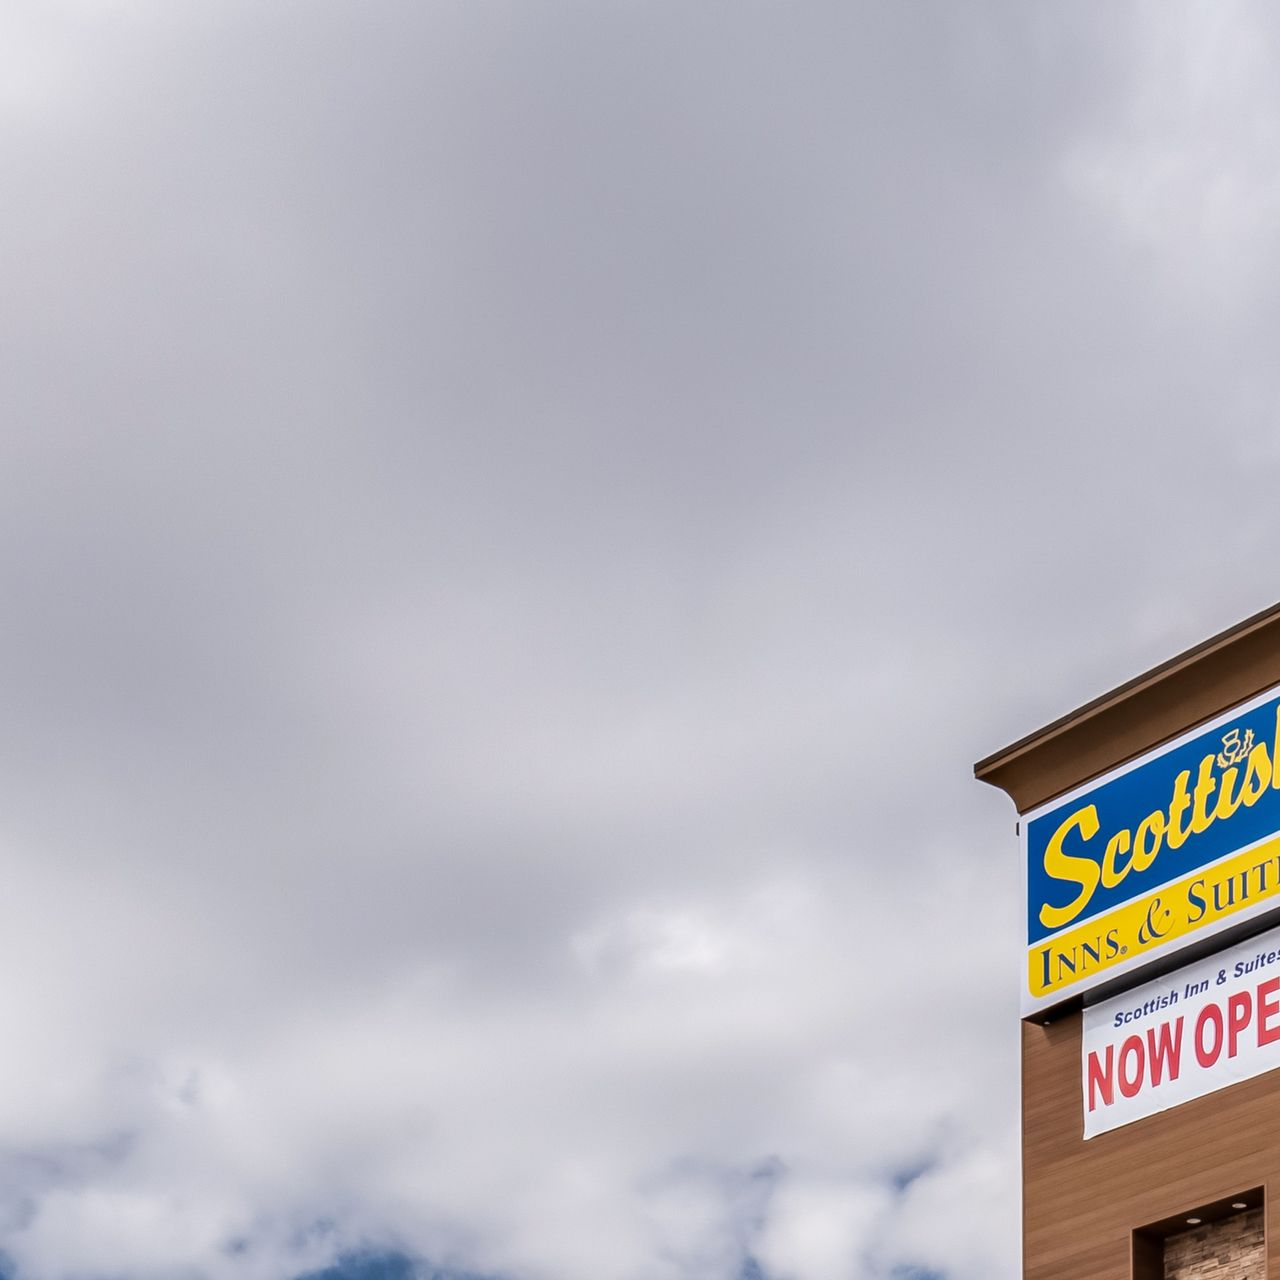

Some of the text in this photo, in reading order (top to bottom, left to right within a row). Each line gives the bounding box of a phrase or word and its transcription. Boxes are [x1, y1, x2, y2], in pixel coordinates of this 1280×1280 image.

[1137, 898, 1175, 945] &
[1113, 991, 1179, 1028] Scottish
[1183, 979, 1210, 1000] Inn
[1215, 969, 1227, 986] &
[1087, 1015, 1185, 1113] NOW
